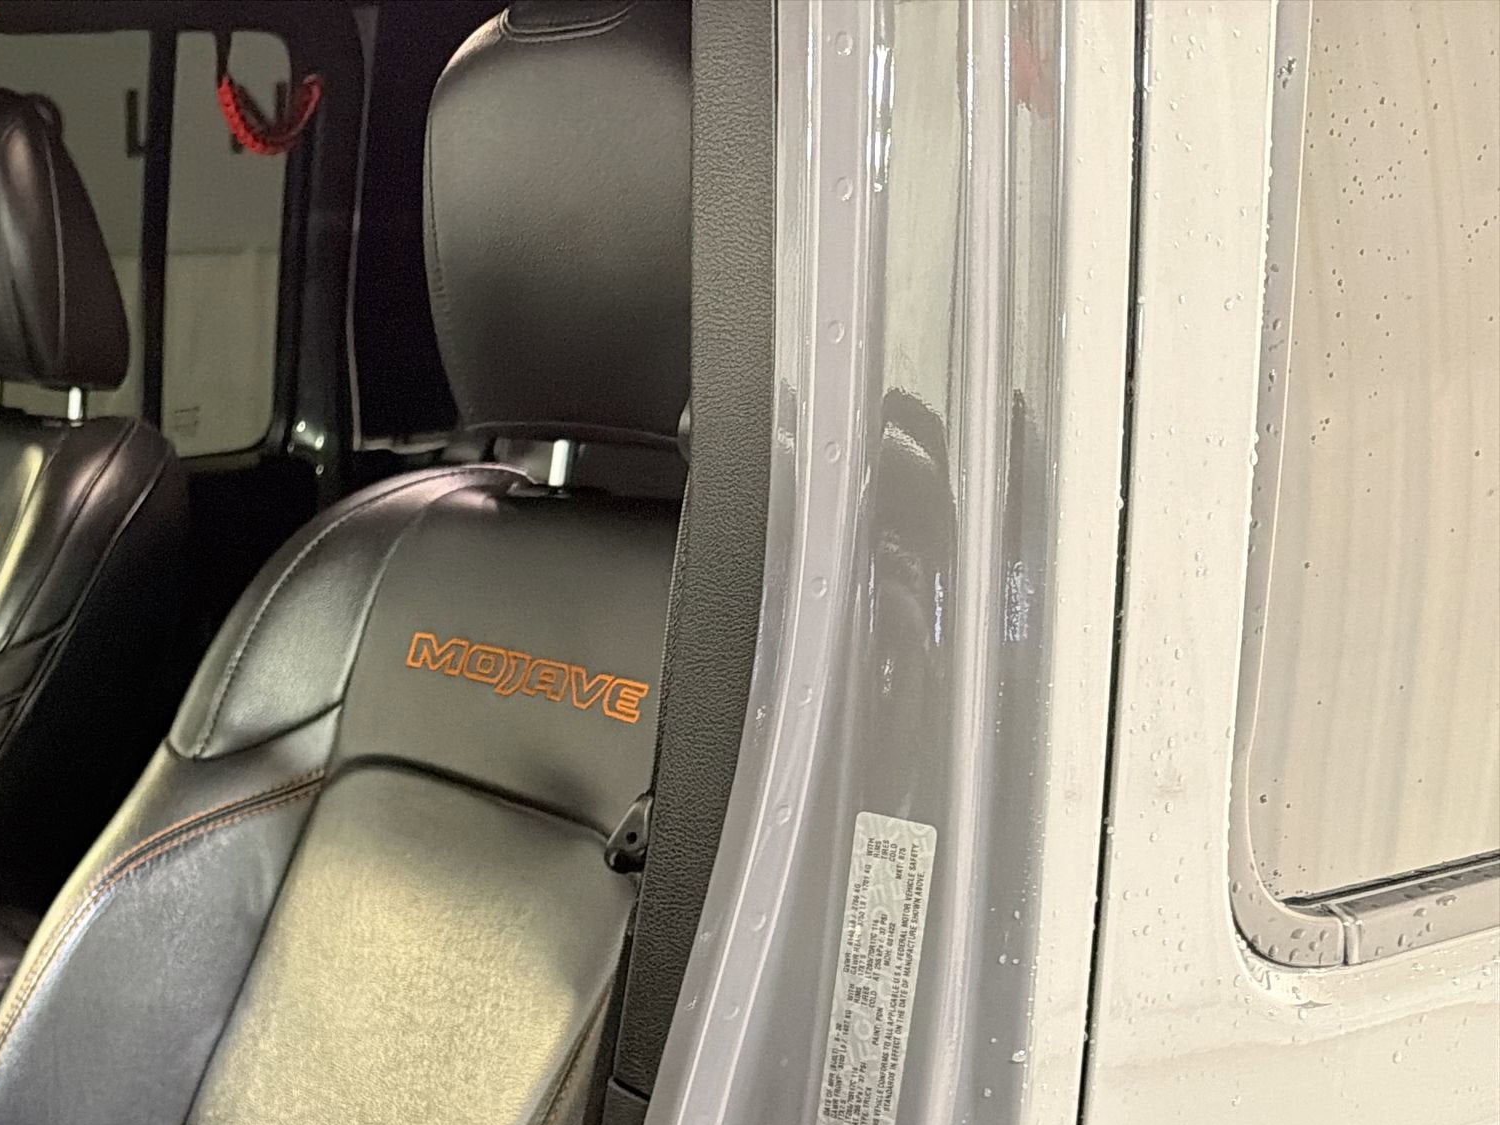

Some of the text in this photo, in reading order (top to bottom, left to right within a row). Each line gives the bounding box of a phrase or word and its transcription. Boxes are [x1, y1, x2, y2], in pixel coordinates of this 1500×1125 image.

[405, 631, 650, 724] MOJAVE
[908, 842, 921, 871] SAFETY
[904, 872, 916, 901] VEHICLE
[900, 902, 912, 928] MOTOR
[910, 897, 923, 924] SHOWN
[902, 924, 918, 977] MANUFACTURE
[898, 988, 908, 1008] DATE
[895, 1008, 905, 1023] THE
[883, 1026, 893, 1040] ALL
[876, 1050, 889, 1088] CONFORMS
